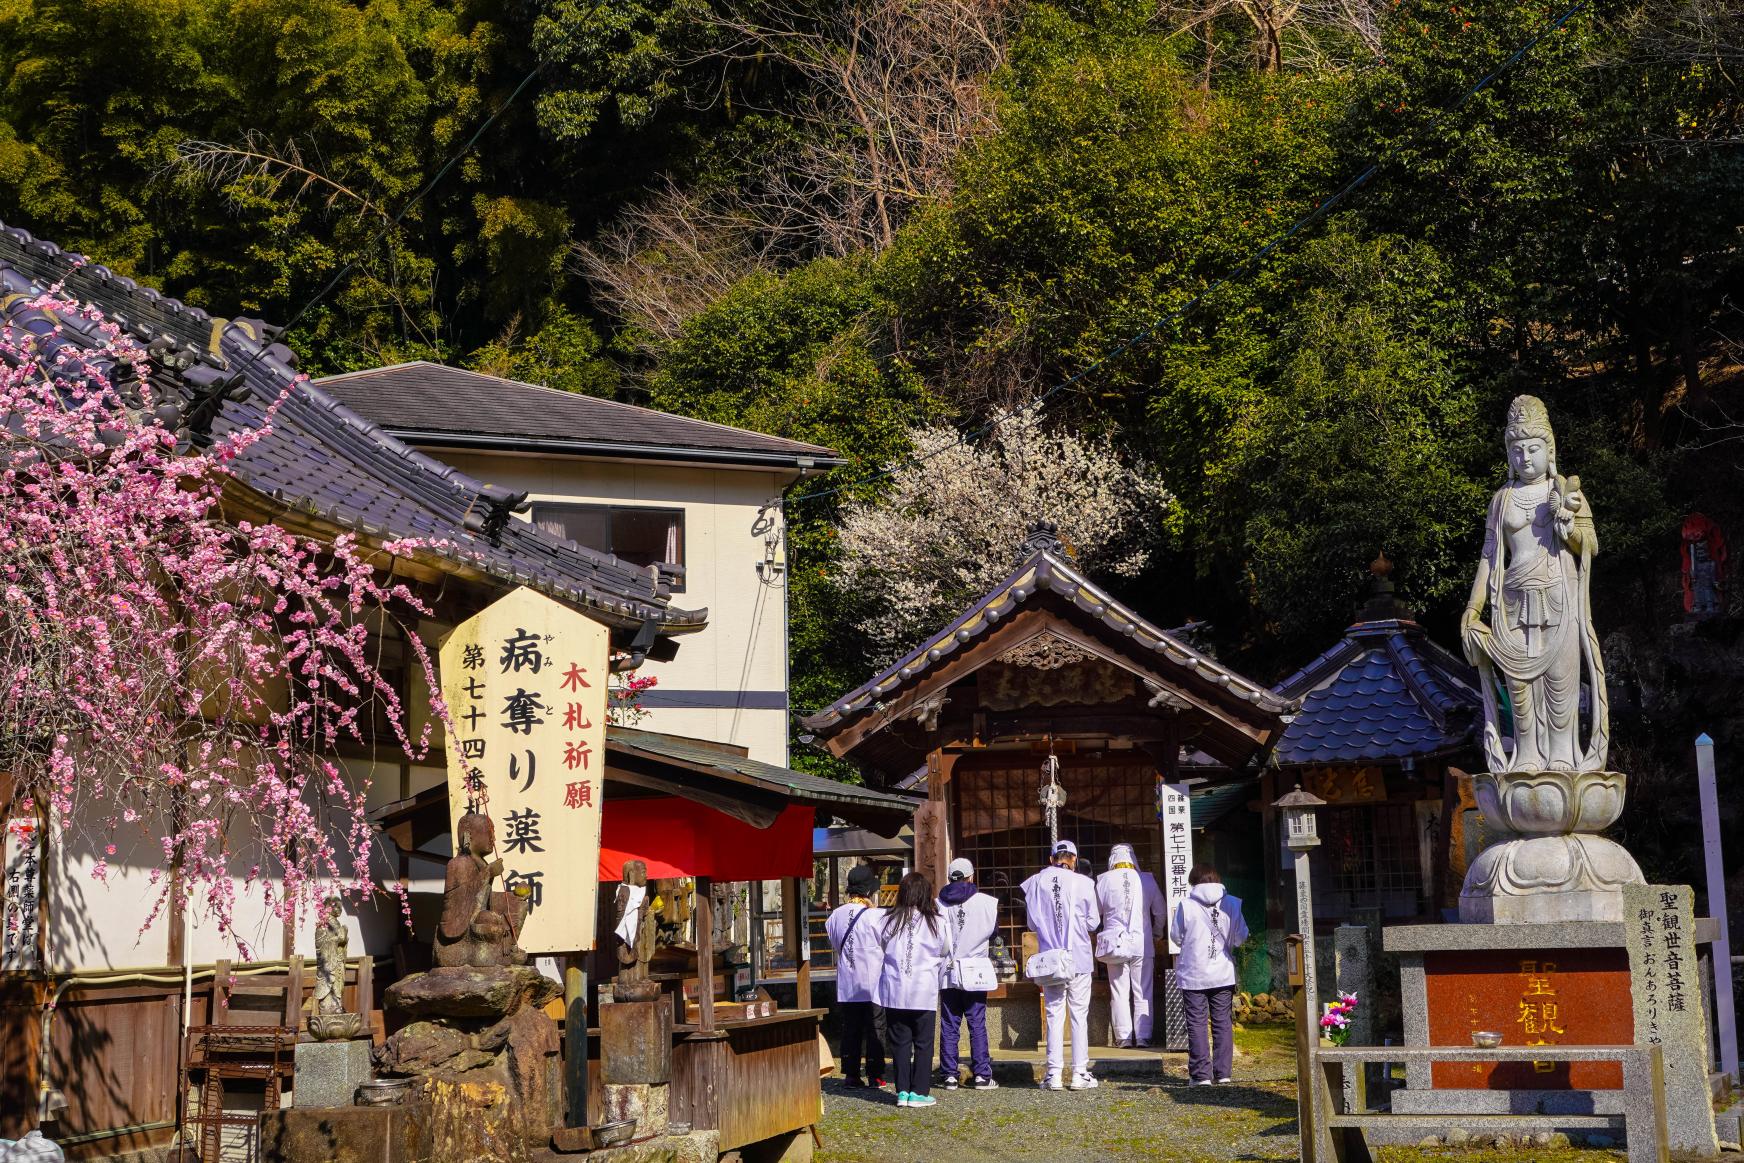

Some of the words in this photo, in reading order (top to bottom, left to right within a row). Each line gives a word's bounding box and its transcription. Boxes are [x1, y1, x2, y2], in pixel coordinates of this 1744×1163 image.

[499, 628, 545, 915] 病奪り薬師
[559, 662, 593, 810] 木札祈願
[1168, 794, 1176, 814] 四国
[1169, 822, 1187, 898] 第七十四番札所
[1659, 891, 1687, 1012] 聖観世音菩薩
